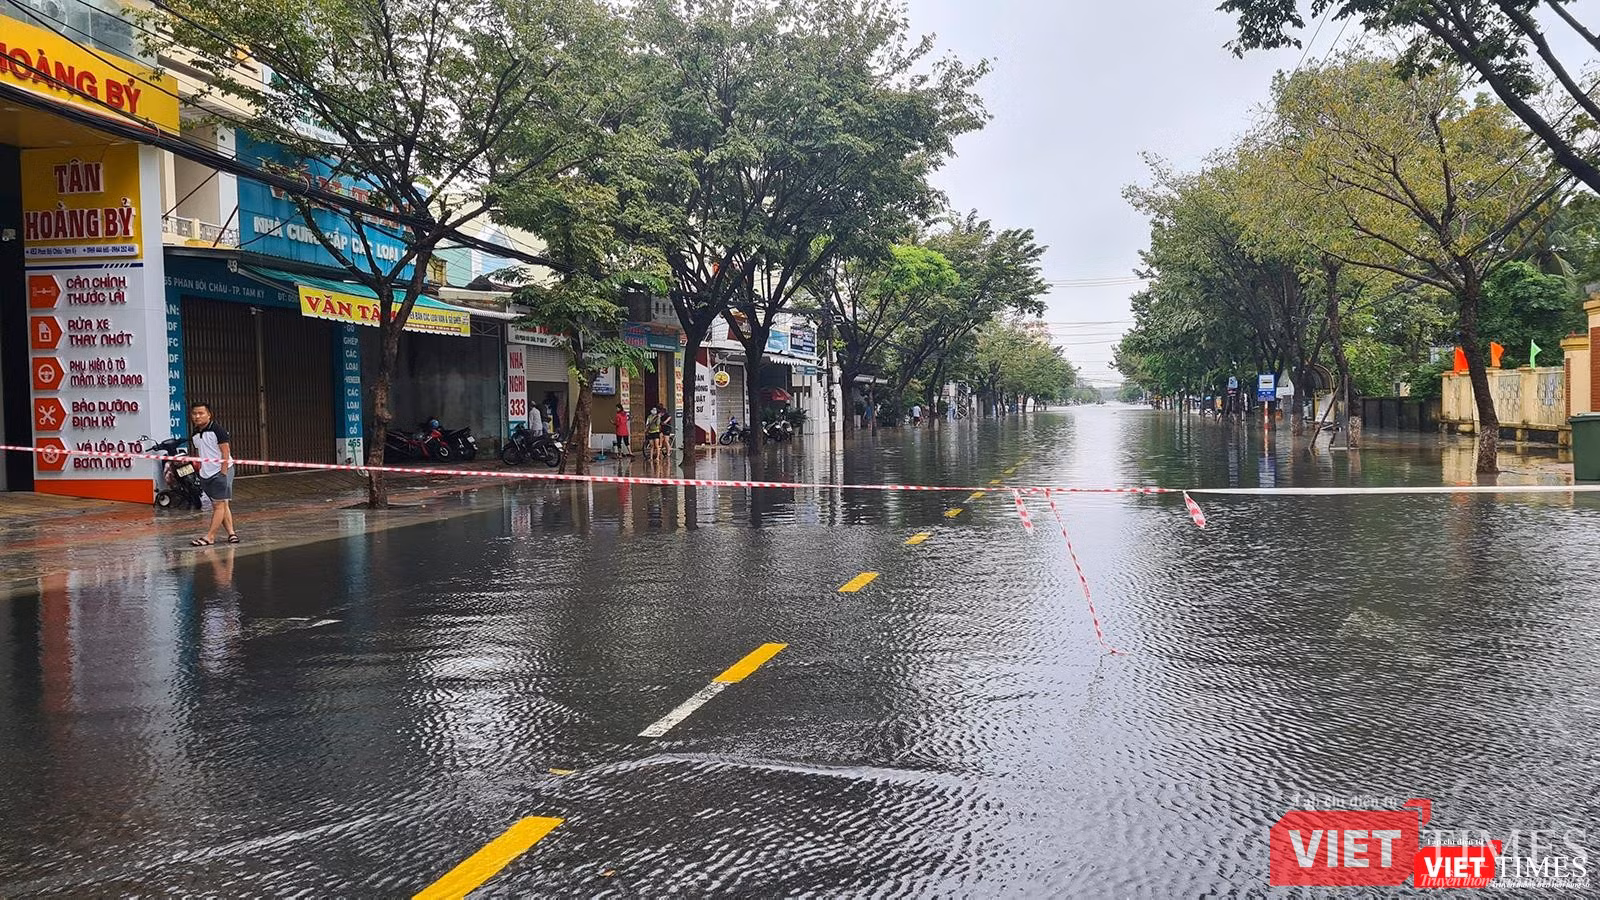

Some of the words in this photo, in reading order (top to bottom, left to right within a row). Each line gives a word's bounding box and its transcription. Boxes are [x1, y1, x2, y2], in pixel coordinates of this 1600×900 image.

[106, 78, 141, 113] BỶ
[53, 158, 103, 194] TÂN
[25, 201, 102, 240] HOÀNG
[104, 198, 134, 238] BỶ
[254, 216, 283, 238] NHÀ
[66, 275, 90, 289] CÂN
[92, 273, 127, 289] CHỈNH
[164, 276, 172, 286] 55
[173, 277, 194, 289] PHAN
[208, 281, 228, 293] CHÂU
[242, 287, 256, 298] TAM
[67, 289, 106, 304] THƯỚC
[305, 294, 352, 318] VĂN
[68, 316, 93, 330] RỬA
[96, 319, 109, 330] XE
[167, 321, 178, 331] DF
[69, 334, 98, 346] THAY
[100, 330, 133, 345] NHỚT
[168, 337, 179, 347] FC
[69, 361, 86, 373] PHỤ
[107, 357, 113, 370] Ô
[115, 357, 126, 370] TÔ
[168, 353, 179, 363] DF
[97, 375, 107, 385] XE
[107, 374, 119, 385] ĐA
[120, 374, 143, 388] DẠNG
[72, 398, 95, 412] BẢO
[98, 399, 139, 413] DƯỠNG
[510, 399, 526, 416] 333
[72, 416, 98, 431] ĐỊNH
[101, 413, 115, 427] KỲ
[76, 440, 92, 452] VÁ
[95, 438, 114, 453] LỐP
[117, 440, 126, 453] Ô
[128, 441, 142, 453] TÔ
[73, 458, 102, 469] BƠM
[105, 458, 131, 469] NITƠ
